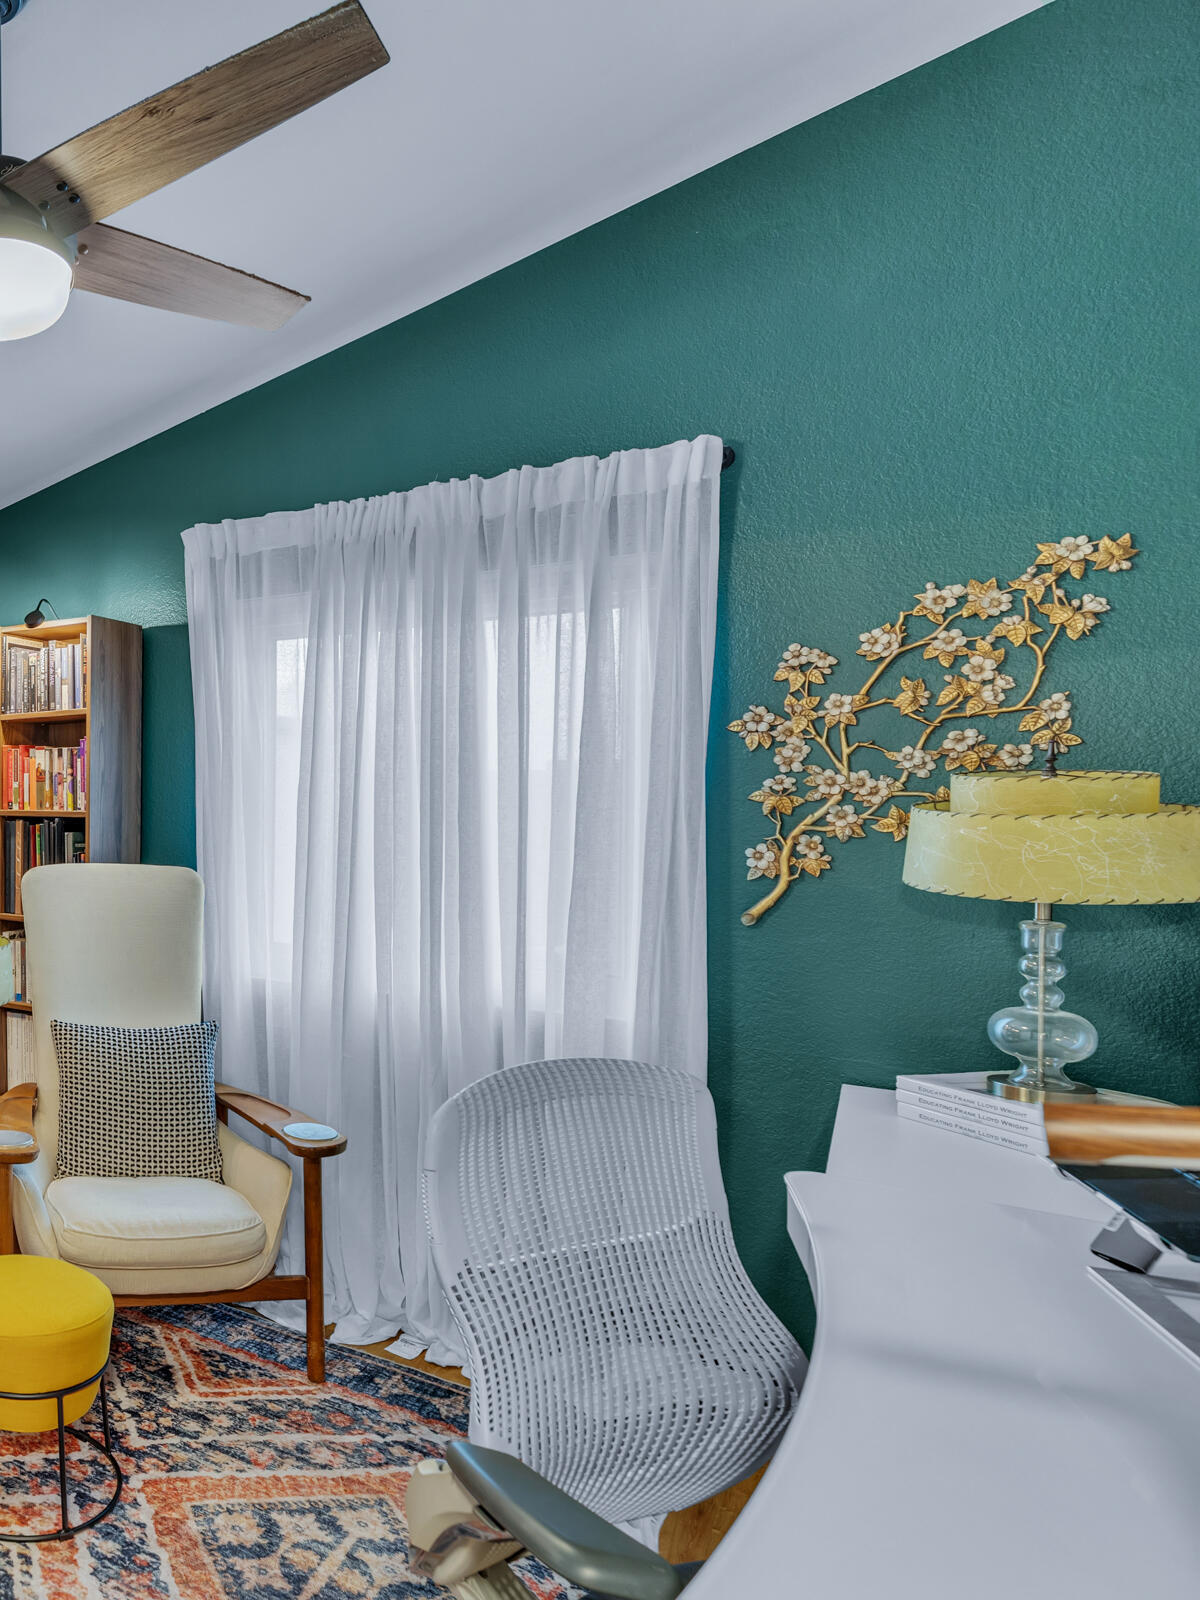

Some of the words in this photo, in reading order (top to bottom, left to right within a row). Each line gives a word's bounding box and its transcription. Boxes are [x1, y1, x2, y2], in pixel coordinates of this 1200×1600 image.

[918, 1086, 952, 1099] EDUCATING
[953, 1095, 975, 1105] FRANK
[977, 1101, 999, 1111] LLOYD
[1000, 1107, 1028, 1118] WRIGHT
[918, 1097, 953, 1112] EDUCATING
[954, 1107, 976, 1118] FRANK
[978, 1114, 999, 1124] LLOYD
[1000, 1120, 1029, 1131] WRIGHT
[919, 1113, 953, 1128] EDUCATING
[954, 1124, 976, 1134] FRANK
[978, 1130, 999, 1141] LLOYD
[1000, 1137, 1028, 1149] WRIGHT
